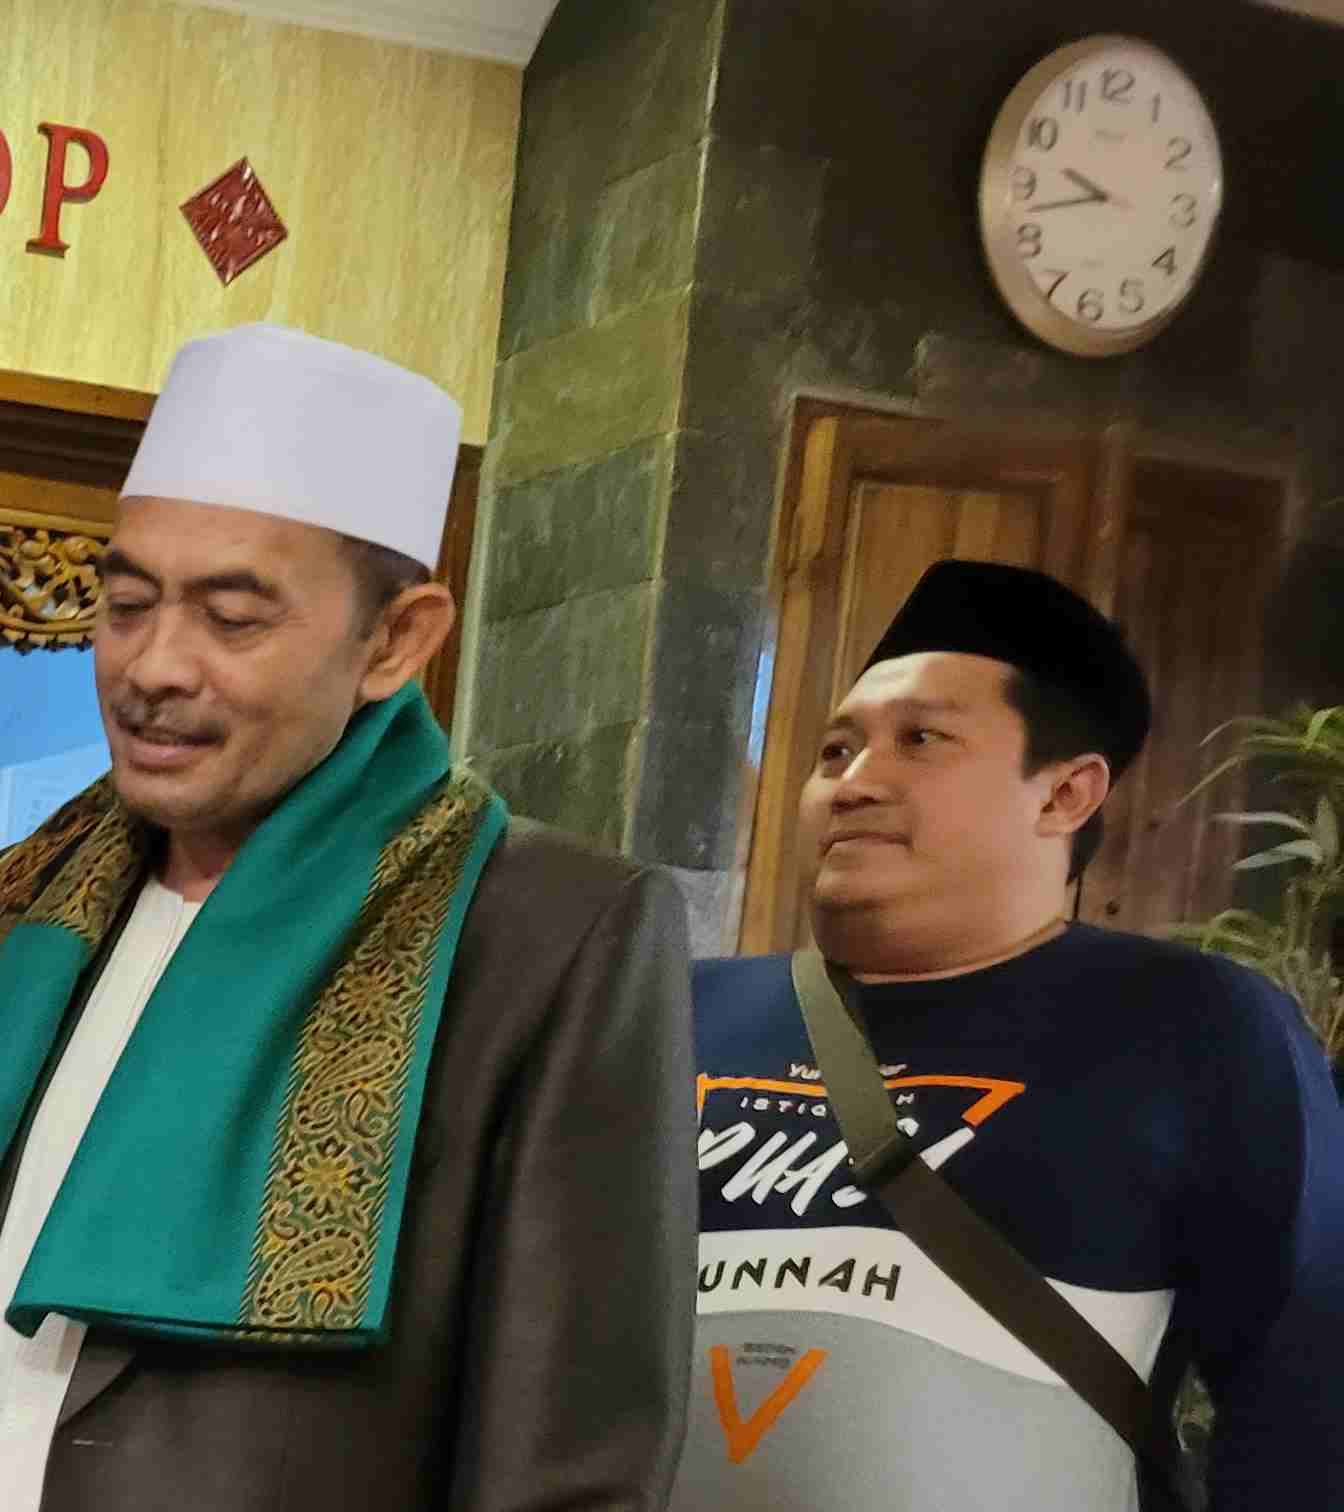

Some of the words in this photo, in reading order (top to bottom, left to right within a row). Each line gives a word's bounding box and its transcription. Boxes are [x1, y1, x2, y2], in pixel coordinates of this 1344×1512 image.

[1062, 80, 1088, 112] 11
[1100, 67, 1135, 103] 12
[1150, 93, 1162, 123] 1
[1163, 136, 1192, 171] 2
[1012, 166, 1037, 200] 9
[1168, 193, 1197, 230] 3
[1016, 222, 1041, 259] 8
[1151, 245, 1178, 276] 4
[1043, 267, 1071, 299] 7
[1119, 278, 1145, 314] 5
[1076, 288, 1104, 322] 6
[698, 1256, 902, 1302] UNNAH
